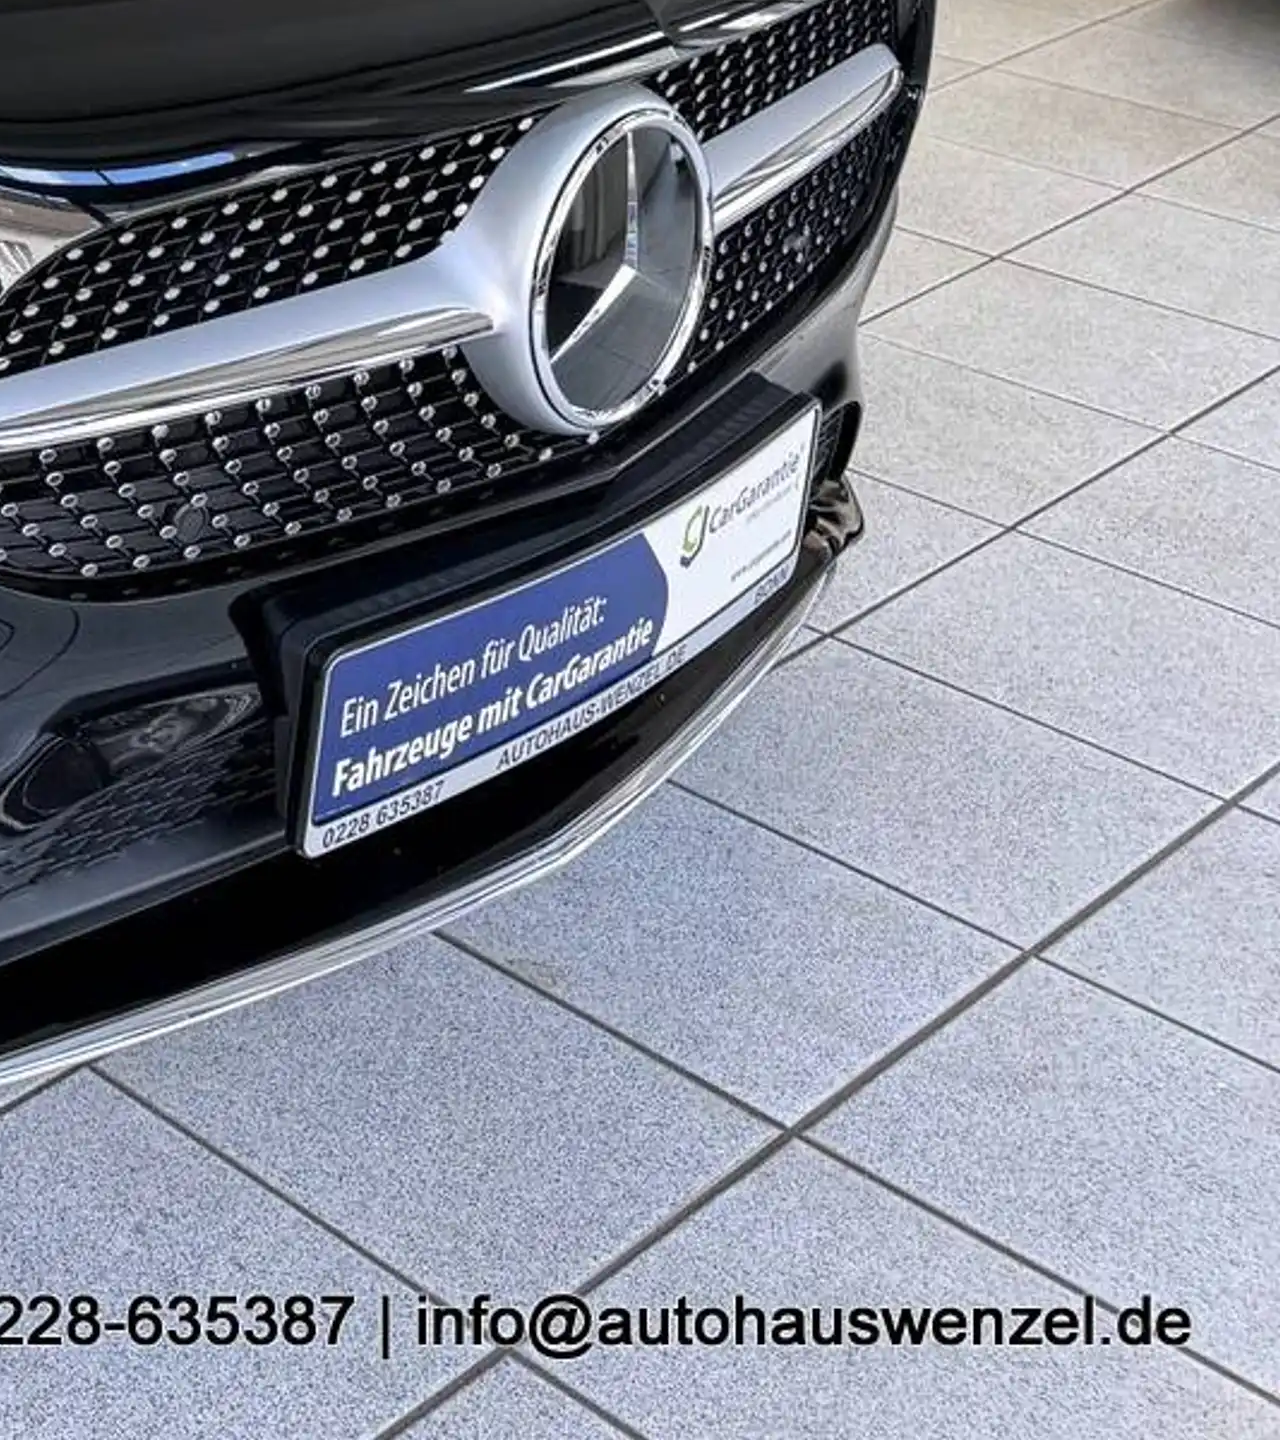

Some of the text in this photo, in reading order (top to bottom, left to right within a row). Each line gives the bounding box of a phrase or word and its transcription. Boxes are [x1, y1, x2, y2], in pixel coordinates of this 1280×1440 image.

[709, 451, 800, 534] CarGarantie
[332, 616, 653, 797] Fahrzeuge mit CarGarantie
[340, 595, 608, 739] Ein Zeichen für Qualität:
[321, 811, 371, 850] 0228
[374, 780, 446, 826] 635387
